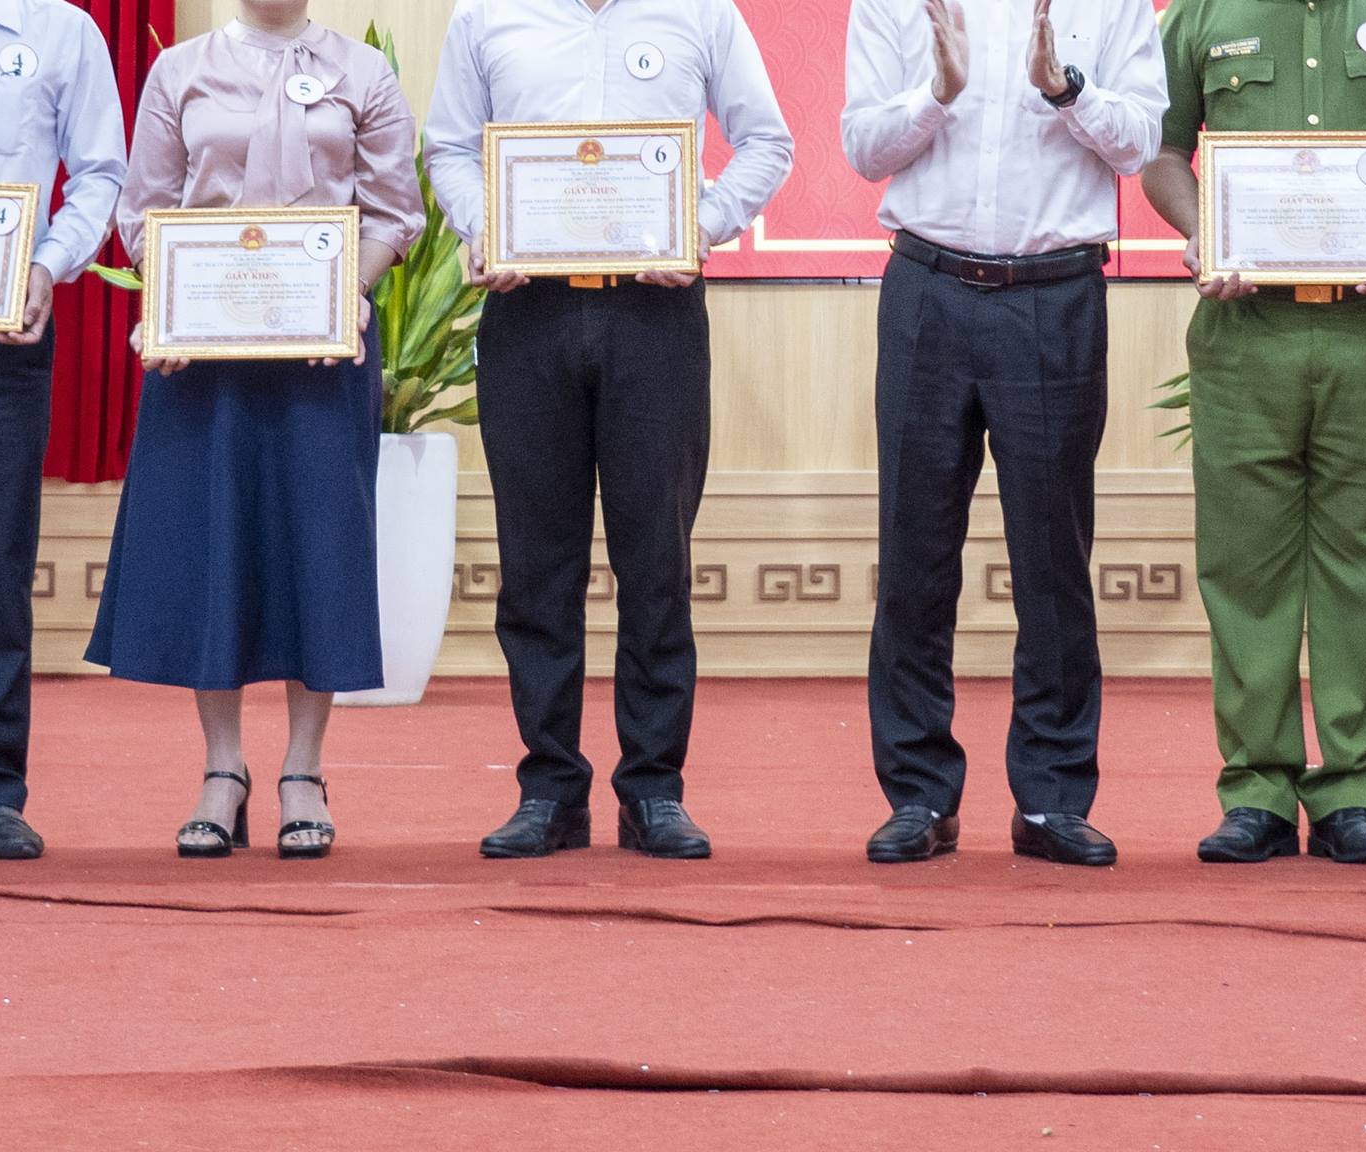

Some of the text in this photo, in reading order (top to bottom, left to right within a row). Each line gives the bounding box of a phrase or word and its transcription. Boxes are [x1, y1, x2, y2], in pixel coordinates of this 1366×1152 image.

[638, 53, 650, 70] 6
[655, 144, 667, 163] 6
[317, 232, 330, 250] 5
